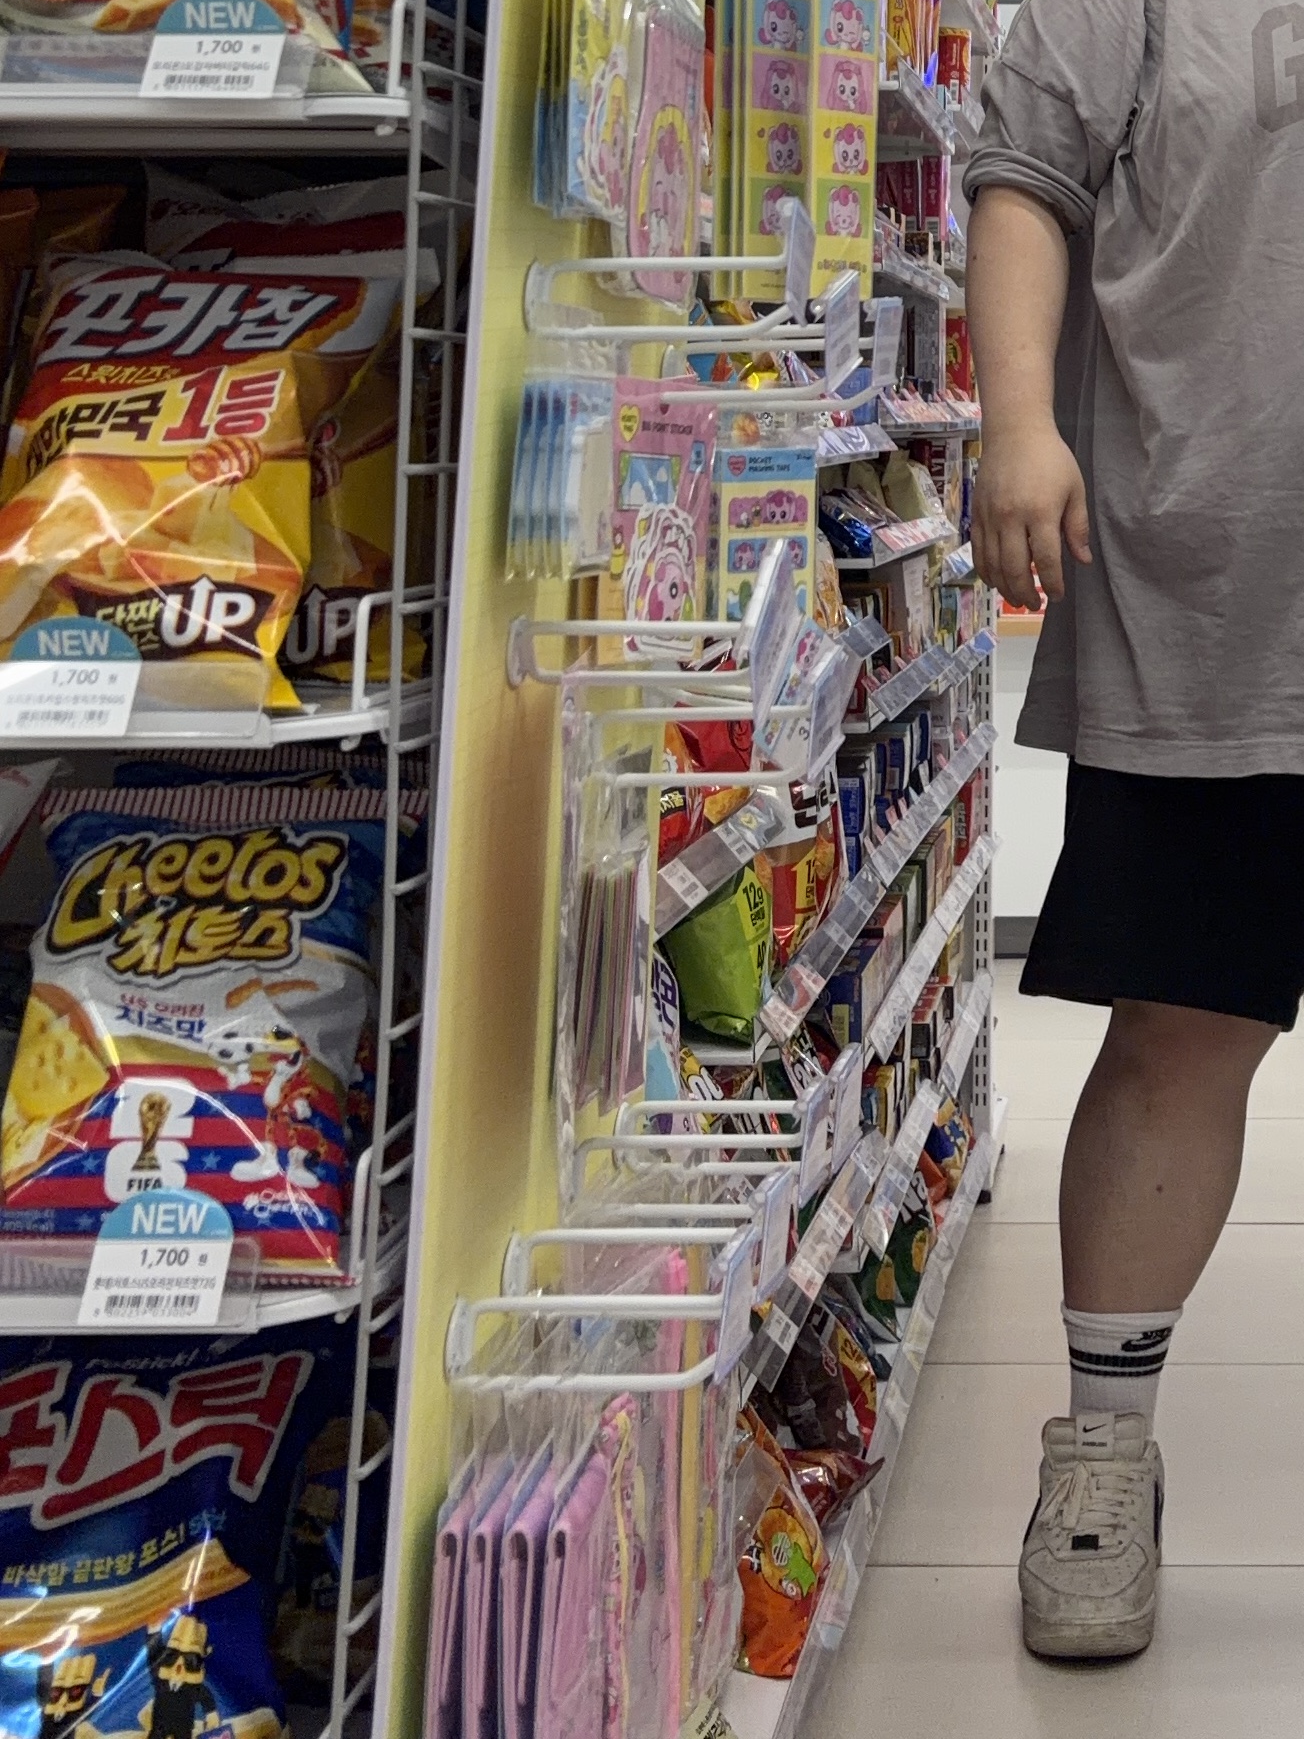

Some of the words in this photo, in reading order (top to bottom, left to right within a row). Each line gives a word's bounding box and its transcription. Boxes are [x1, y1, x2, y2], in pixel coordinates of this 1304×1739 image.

[185, 1, 256, 29] NEW
[197, 40, 243, 56] 1,700
[162, 365, 286, 444] 1등
[161, 575, 256, 648] UP
[37, 629, 110, 657] NEW
[50, 669, 99, 685] 1,700
[47, 828, 342, 954] Cheetos
[742, 881, 764, 910] 12g
[107, 905, 292, 975] 치토스
[115, 1004, 207, 1043] 치즈맛
[131, 1202, 209, 1235] NEW
[140, 1248, 190, 1268] 1,700
